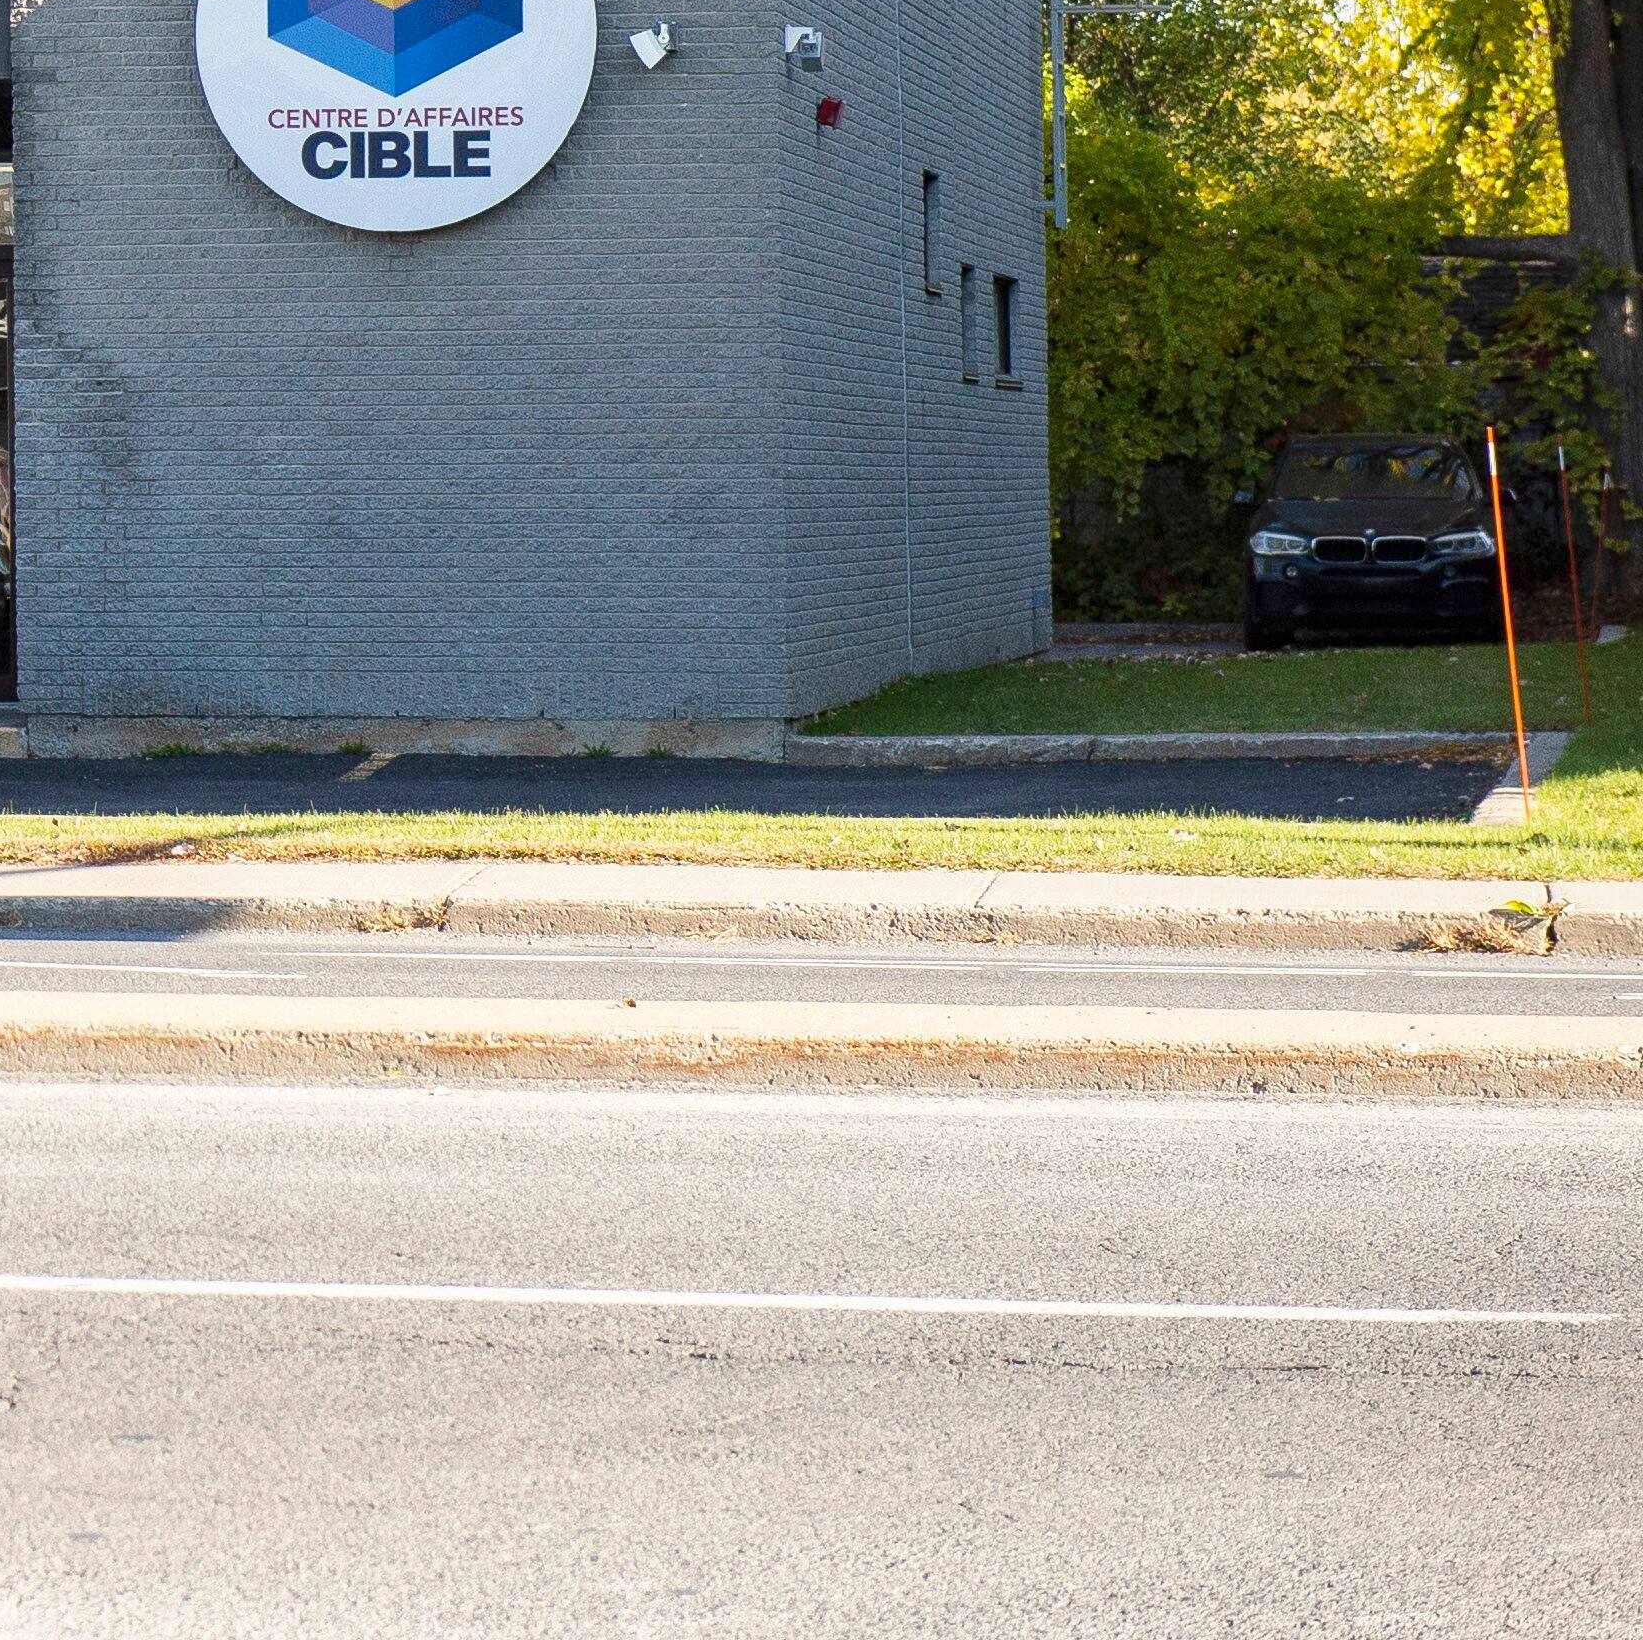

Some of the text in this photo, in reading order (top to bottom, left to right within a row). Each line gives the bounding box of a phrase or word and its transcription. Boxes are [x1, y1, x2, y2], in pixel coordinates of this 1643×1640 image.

[267, 105, 524, 129] CENTRE D'AFFAIRES
[300, 129, 492, 181] CIBLE
